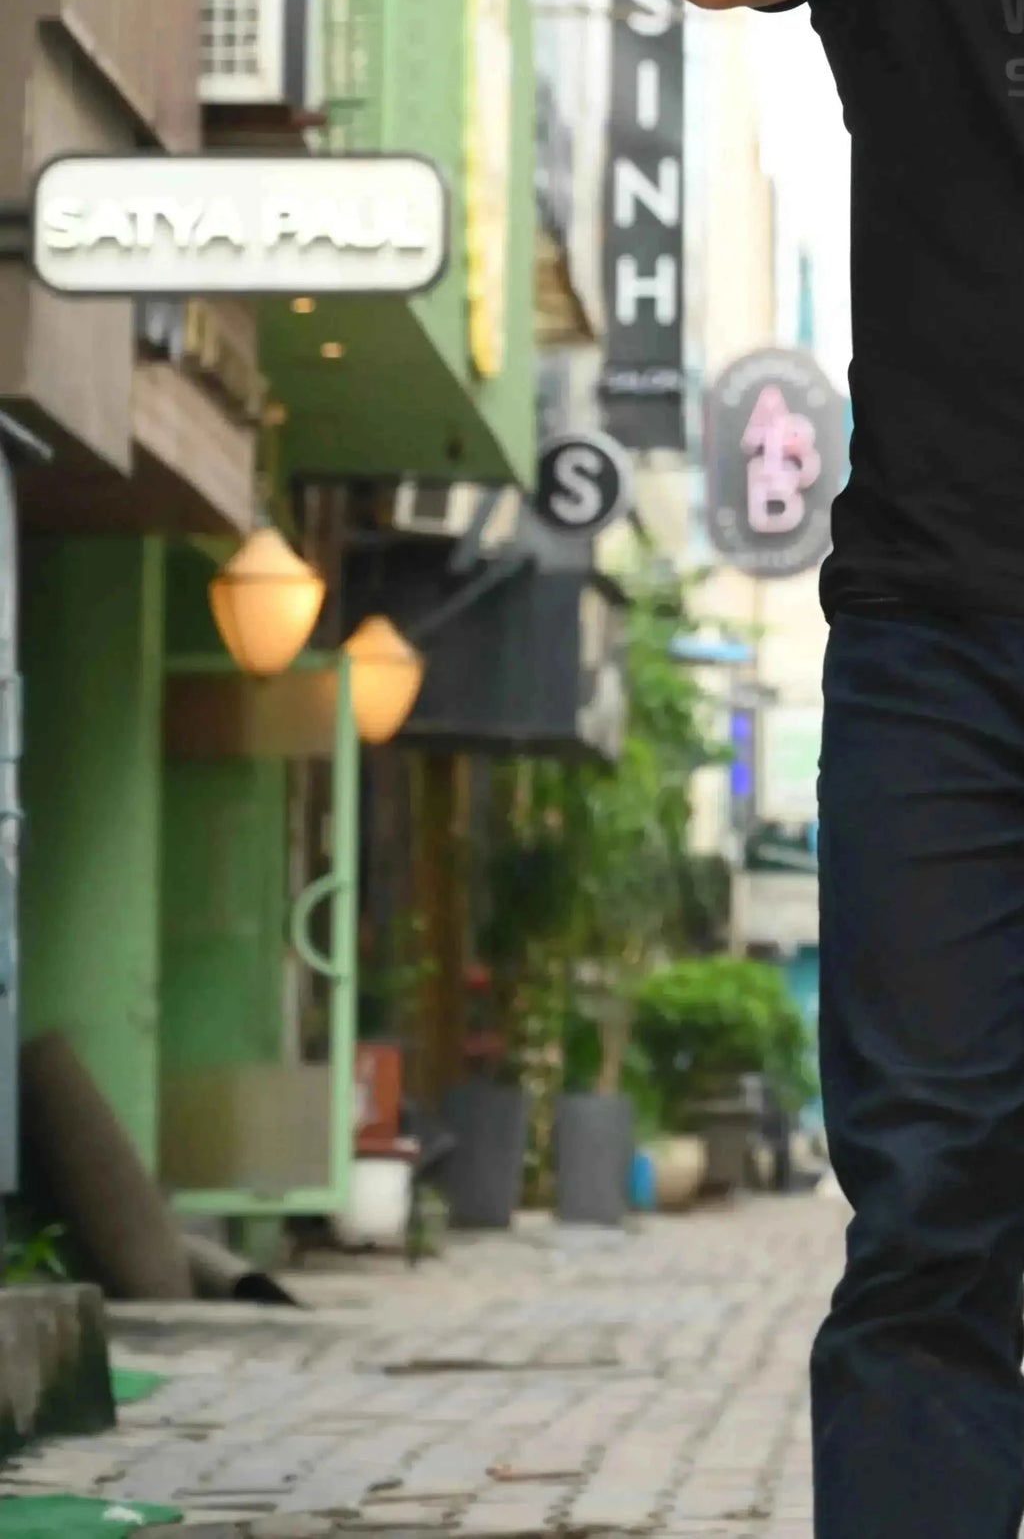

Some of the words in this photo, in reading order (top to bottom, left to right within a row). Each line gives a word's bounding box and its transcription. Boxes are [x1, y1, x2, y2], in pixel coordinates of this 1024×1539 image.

[44, 197, 246, 250] SATYA
[264, 197, 427, 250] PAUL
[549, 444, 604, 527] S
